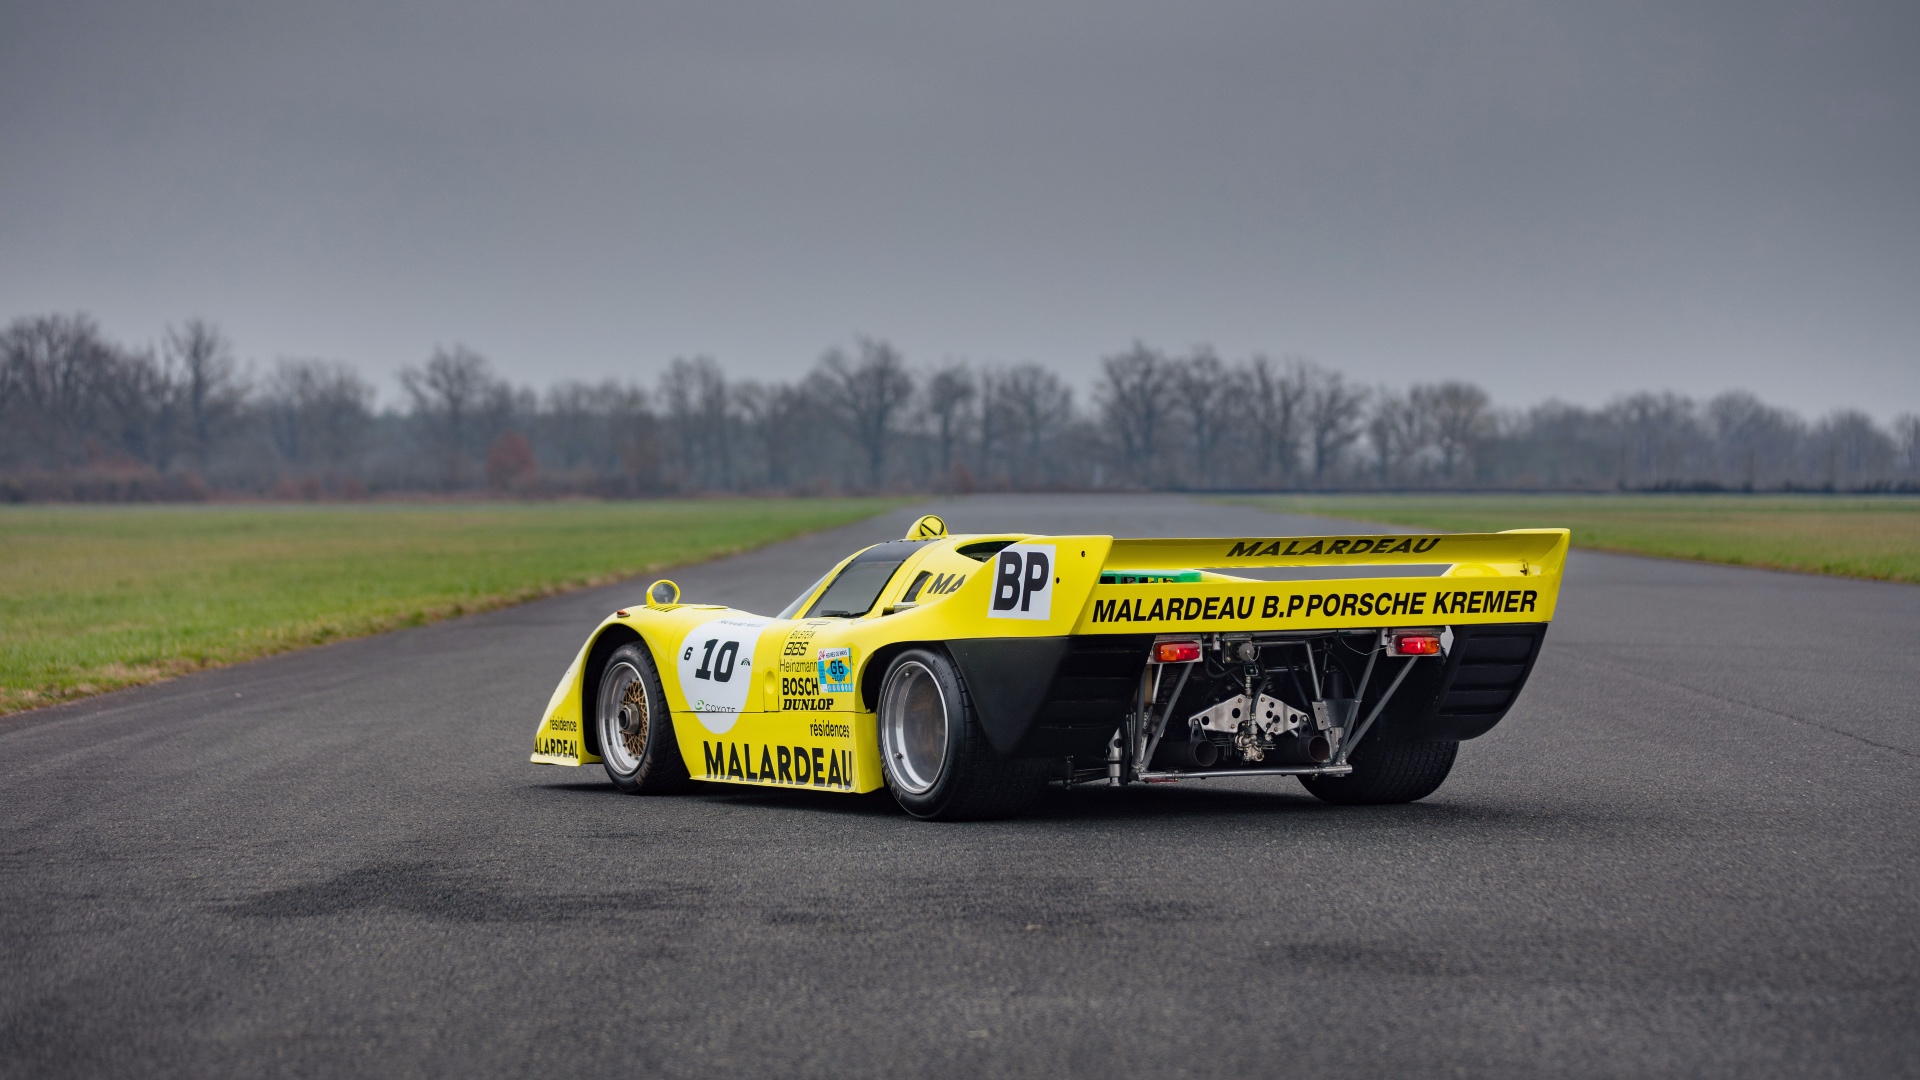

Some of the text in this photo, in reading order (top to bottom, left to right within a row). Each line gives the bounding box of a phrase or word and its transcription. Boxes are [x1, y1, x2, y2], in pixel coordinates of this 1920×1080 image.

[1226, 538, 1441, 557] MALARDEAU
[927, 572, 966, 594] MA
[993, 551, 1049, 611] BP
[1092, 595, 1255, 622] MALARDEAU
[1306, 592, 1426, 617] PORSCHE
[1432, 590, 1538, 614] KREMER
[683, 647, 693, 660] 6
[784, 641, 809, 656] BBS
[695, 639, 740, 683] 10
[780, 659, 818, 672] Heinzmann
[830, 660, 845, 675] G6
[782, 677, 819, 696] BOSCH
[782, 698, 834, 711] DUNLOP
[810, 719, 850, 738] résidences
[703, 741, 852, 791] MALARDEAU
